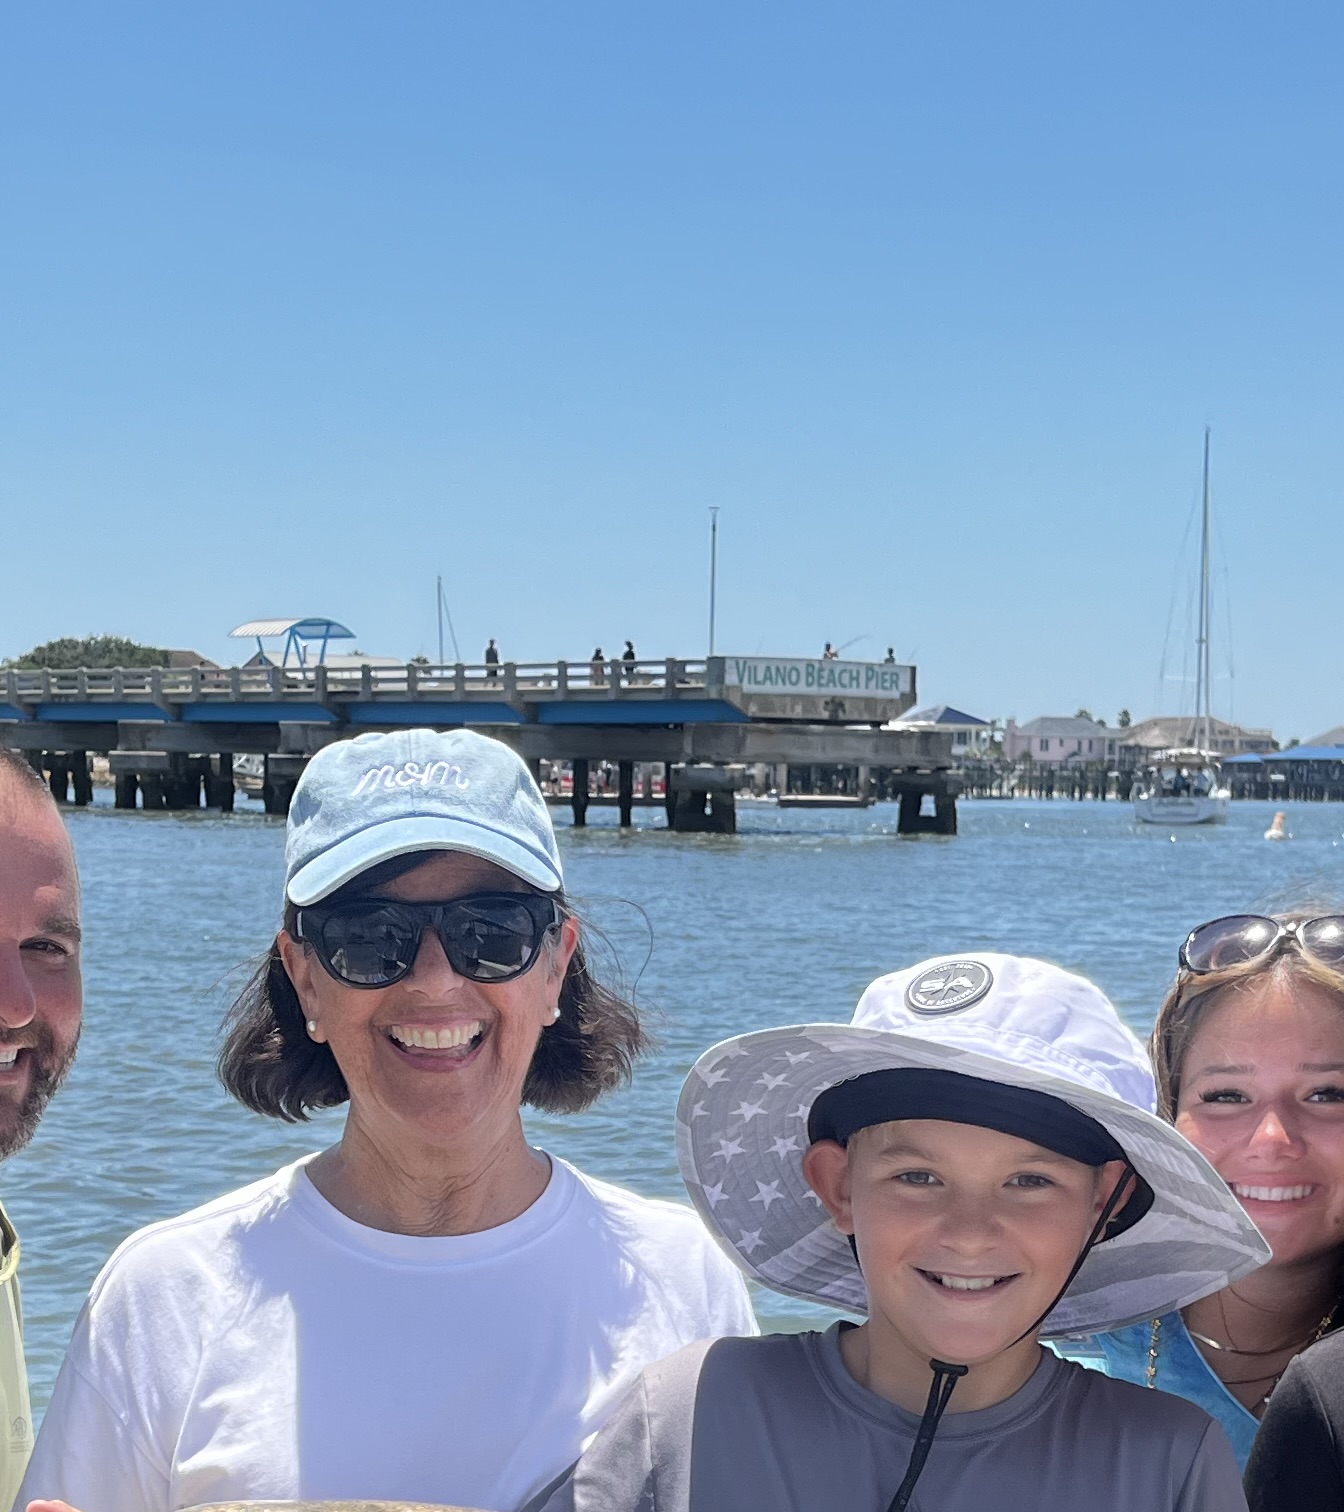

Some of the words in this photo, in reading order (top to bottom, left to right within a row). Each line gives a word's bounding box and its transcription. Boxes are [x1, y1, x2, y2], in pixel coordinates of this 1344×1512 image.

[735, 660, 801, 686] VILANO
[806, 664, 860, 689] BEACH
[865, 667, 899, 691] PIER
